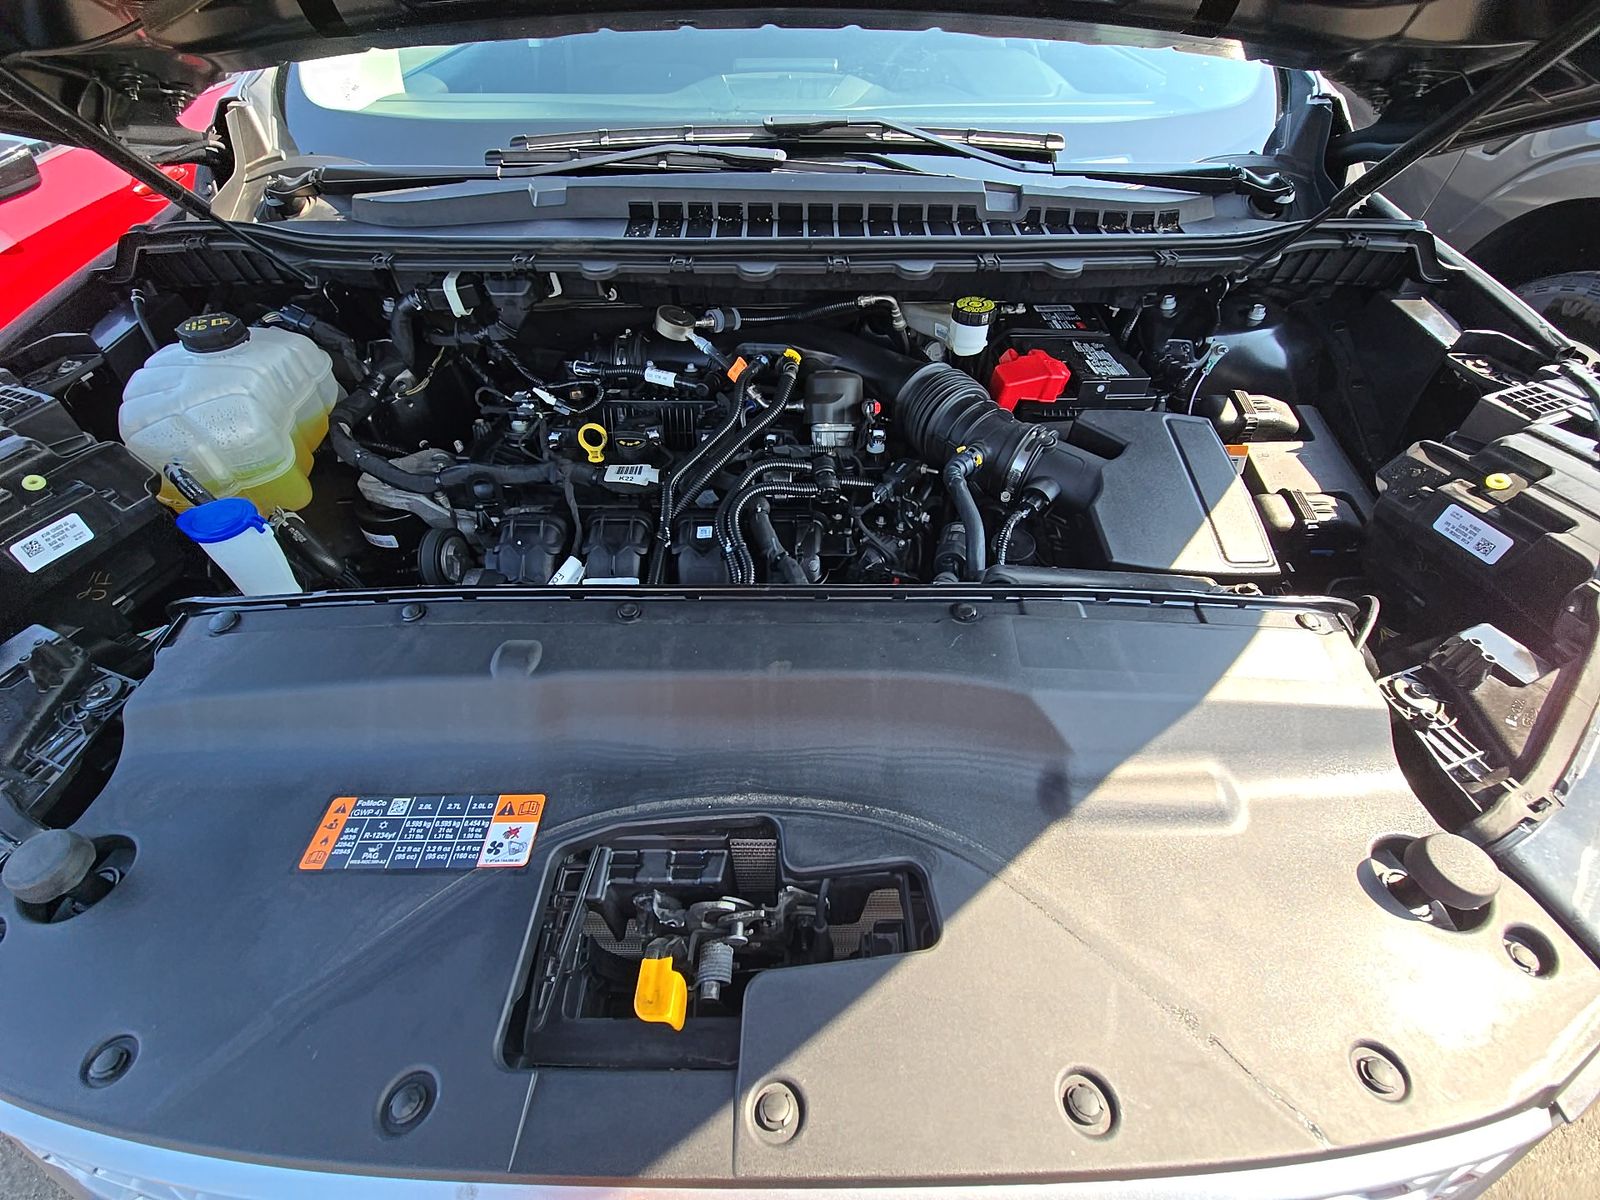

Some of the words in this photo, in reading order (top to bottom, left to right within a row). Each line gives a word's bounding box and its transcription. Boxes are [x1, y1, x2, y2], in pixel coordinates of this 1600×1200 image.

[350, 808, 374, 817] (GWP
[374, 808, 384, 816] 4)
[363, 832, 396, 840] R-1234yf
